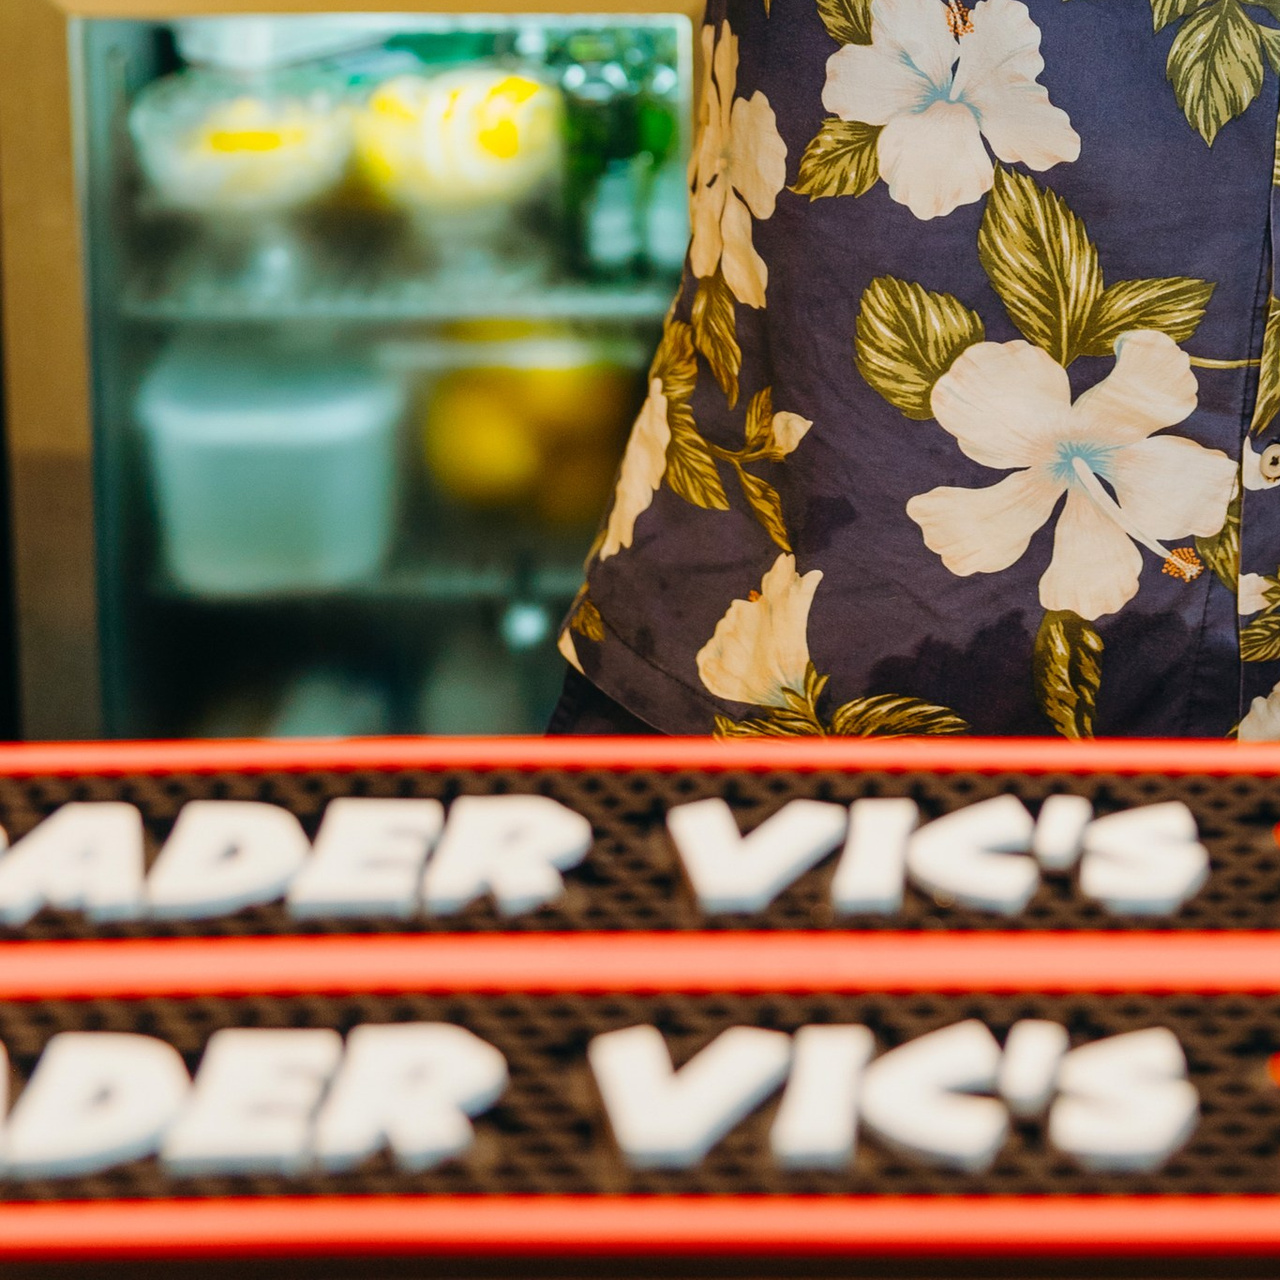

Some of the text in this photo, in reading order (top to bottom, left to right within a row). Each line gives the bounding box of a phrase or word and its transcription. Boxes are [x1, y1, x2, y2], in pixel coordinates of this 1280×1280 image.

[0, 792, 1212, 928] ADER VIC'S
[0, 1018, 1200, 1182] DER VIC'S
